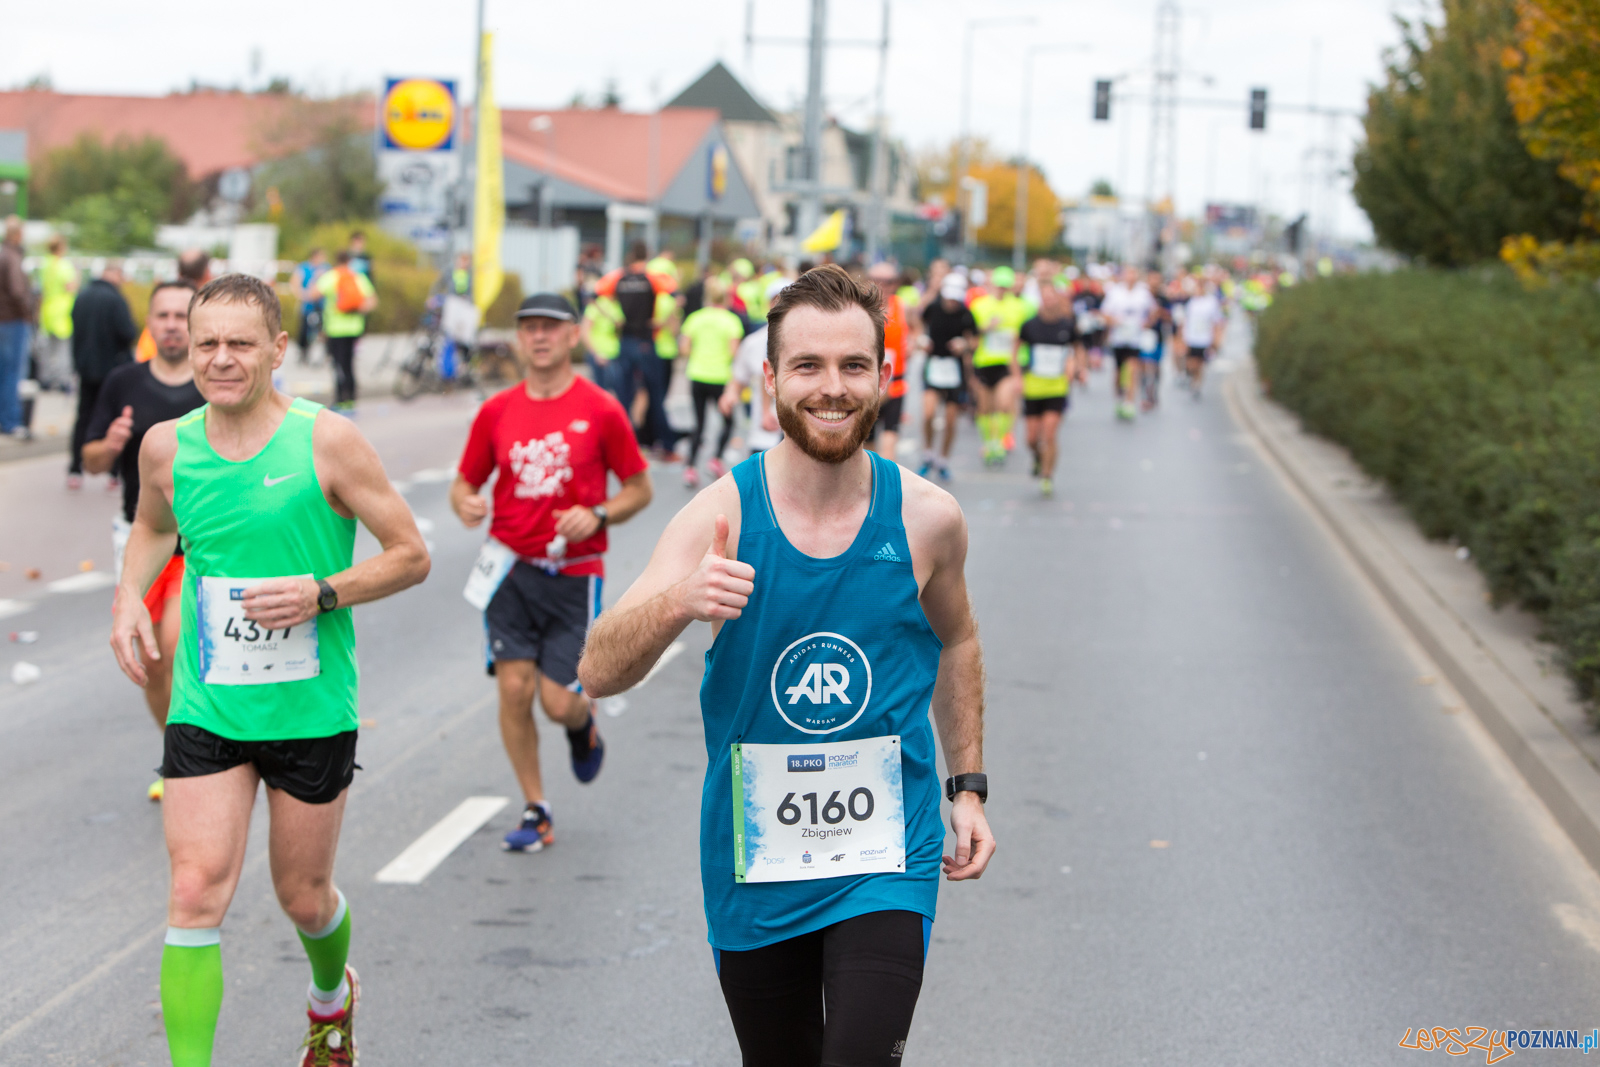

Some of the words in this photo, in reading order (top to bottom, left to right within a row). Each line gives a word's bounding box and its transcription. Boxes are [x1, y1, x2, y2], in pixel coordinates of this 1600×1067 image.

[873, 554, 901, 563] adidas
[242, 642, 278, 652] TOMASZ
[789, 643, 817, 664] ADIDAS
[821, 642, 855, 663] RUNNERS
[784, 662, 853, 705] AR
[805, 717, 836, 725] WARSAW
[791, 759, 803, 768] 18.
[803, 758, 823, 768] PKO
[828, 759, 858, 768] maraton
[777, 786, 875, 826] 6160
[801, 827, 853, 840] Zbigniew
[766, 857, 785, 866] posir
